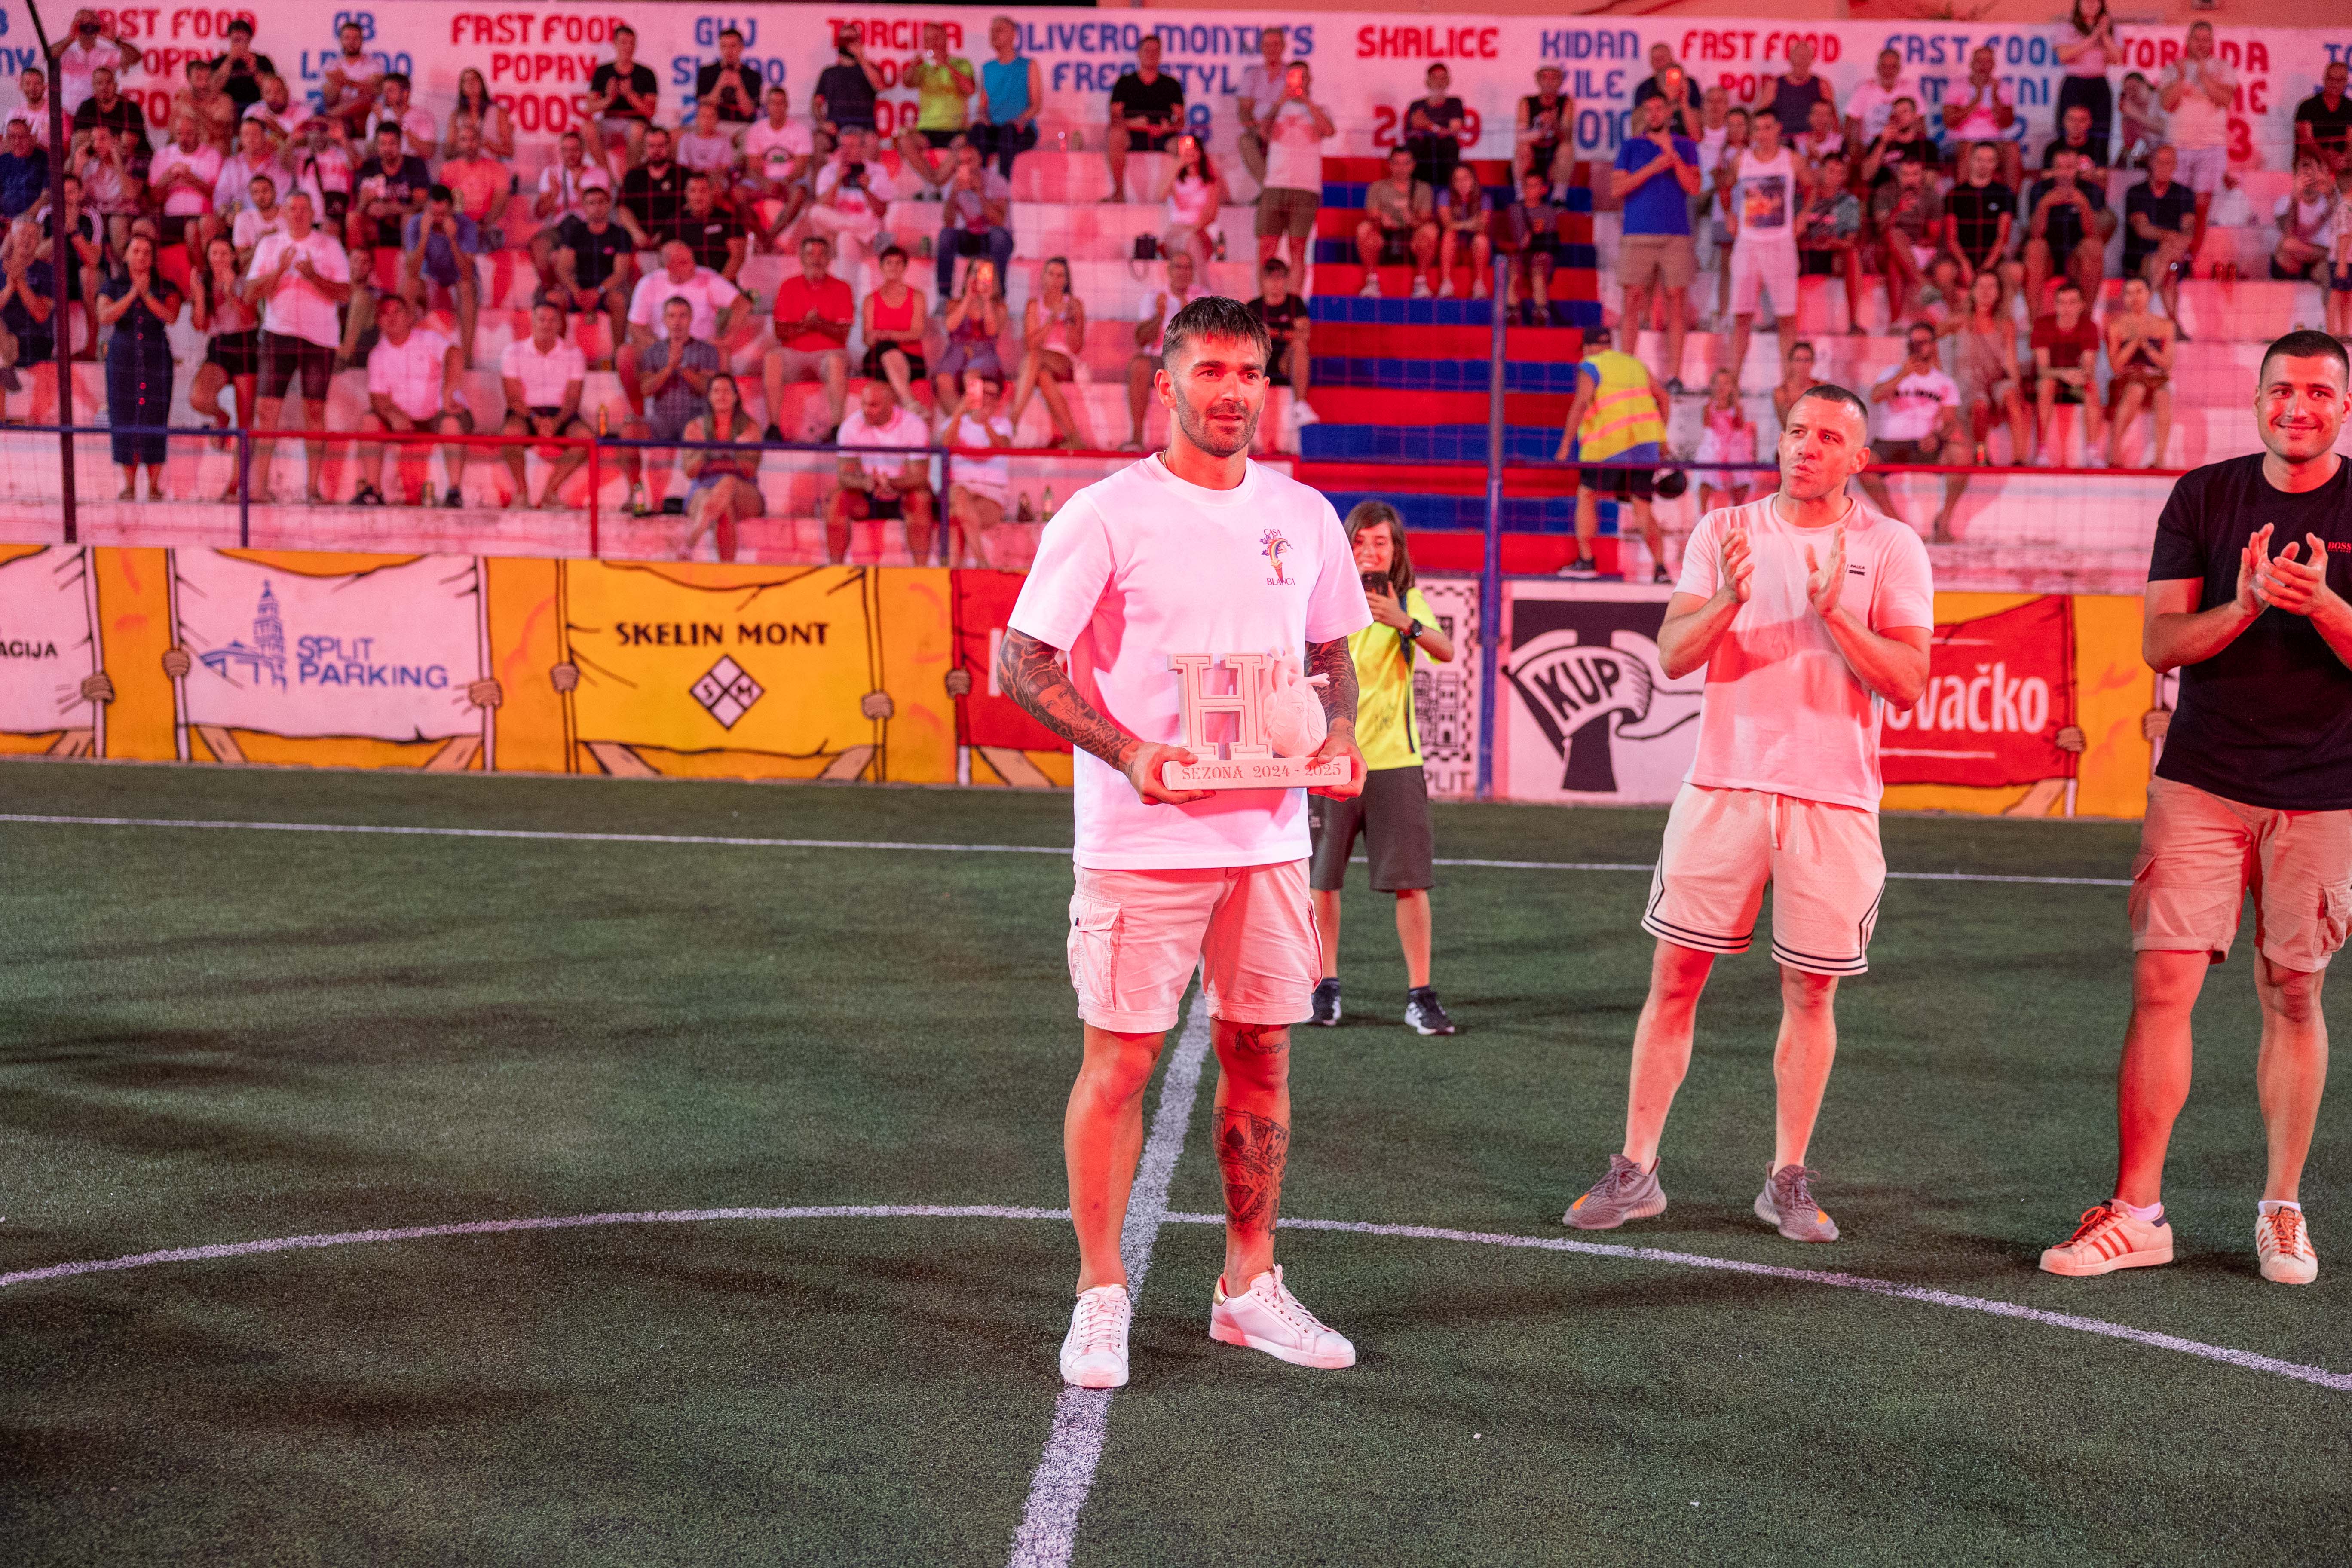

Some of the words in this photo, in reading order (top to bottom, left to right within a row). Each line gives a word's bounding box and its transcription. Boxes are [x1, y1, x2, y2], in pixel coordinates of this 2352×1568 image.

[95, 9, 161, 39] AST
[451, 14, 534, 43] FAST
[828, 20, 962, 49] TRCIA
[1542, 30, 1639, 59] KIDAN
[1682, 31, 1756, 60] FAST
[493, 53, 598, 82] POPAY
[2327, 542, 2352, 551] BOSS
[615, 622, 723, 645] SKELIN
[738, 623, 829, 645] MONT
[297, 636, 375, 662] SPLIT
[299, 663, 448, 688] PARKING
[1533, 658, 1620, 720] KUP
[1182, 766, 1243, 780] SEZONA
[1253, 765, 1290, 778] 2024
[1304, 762, 1342, 777] 2025
